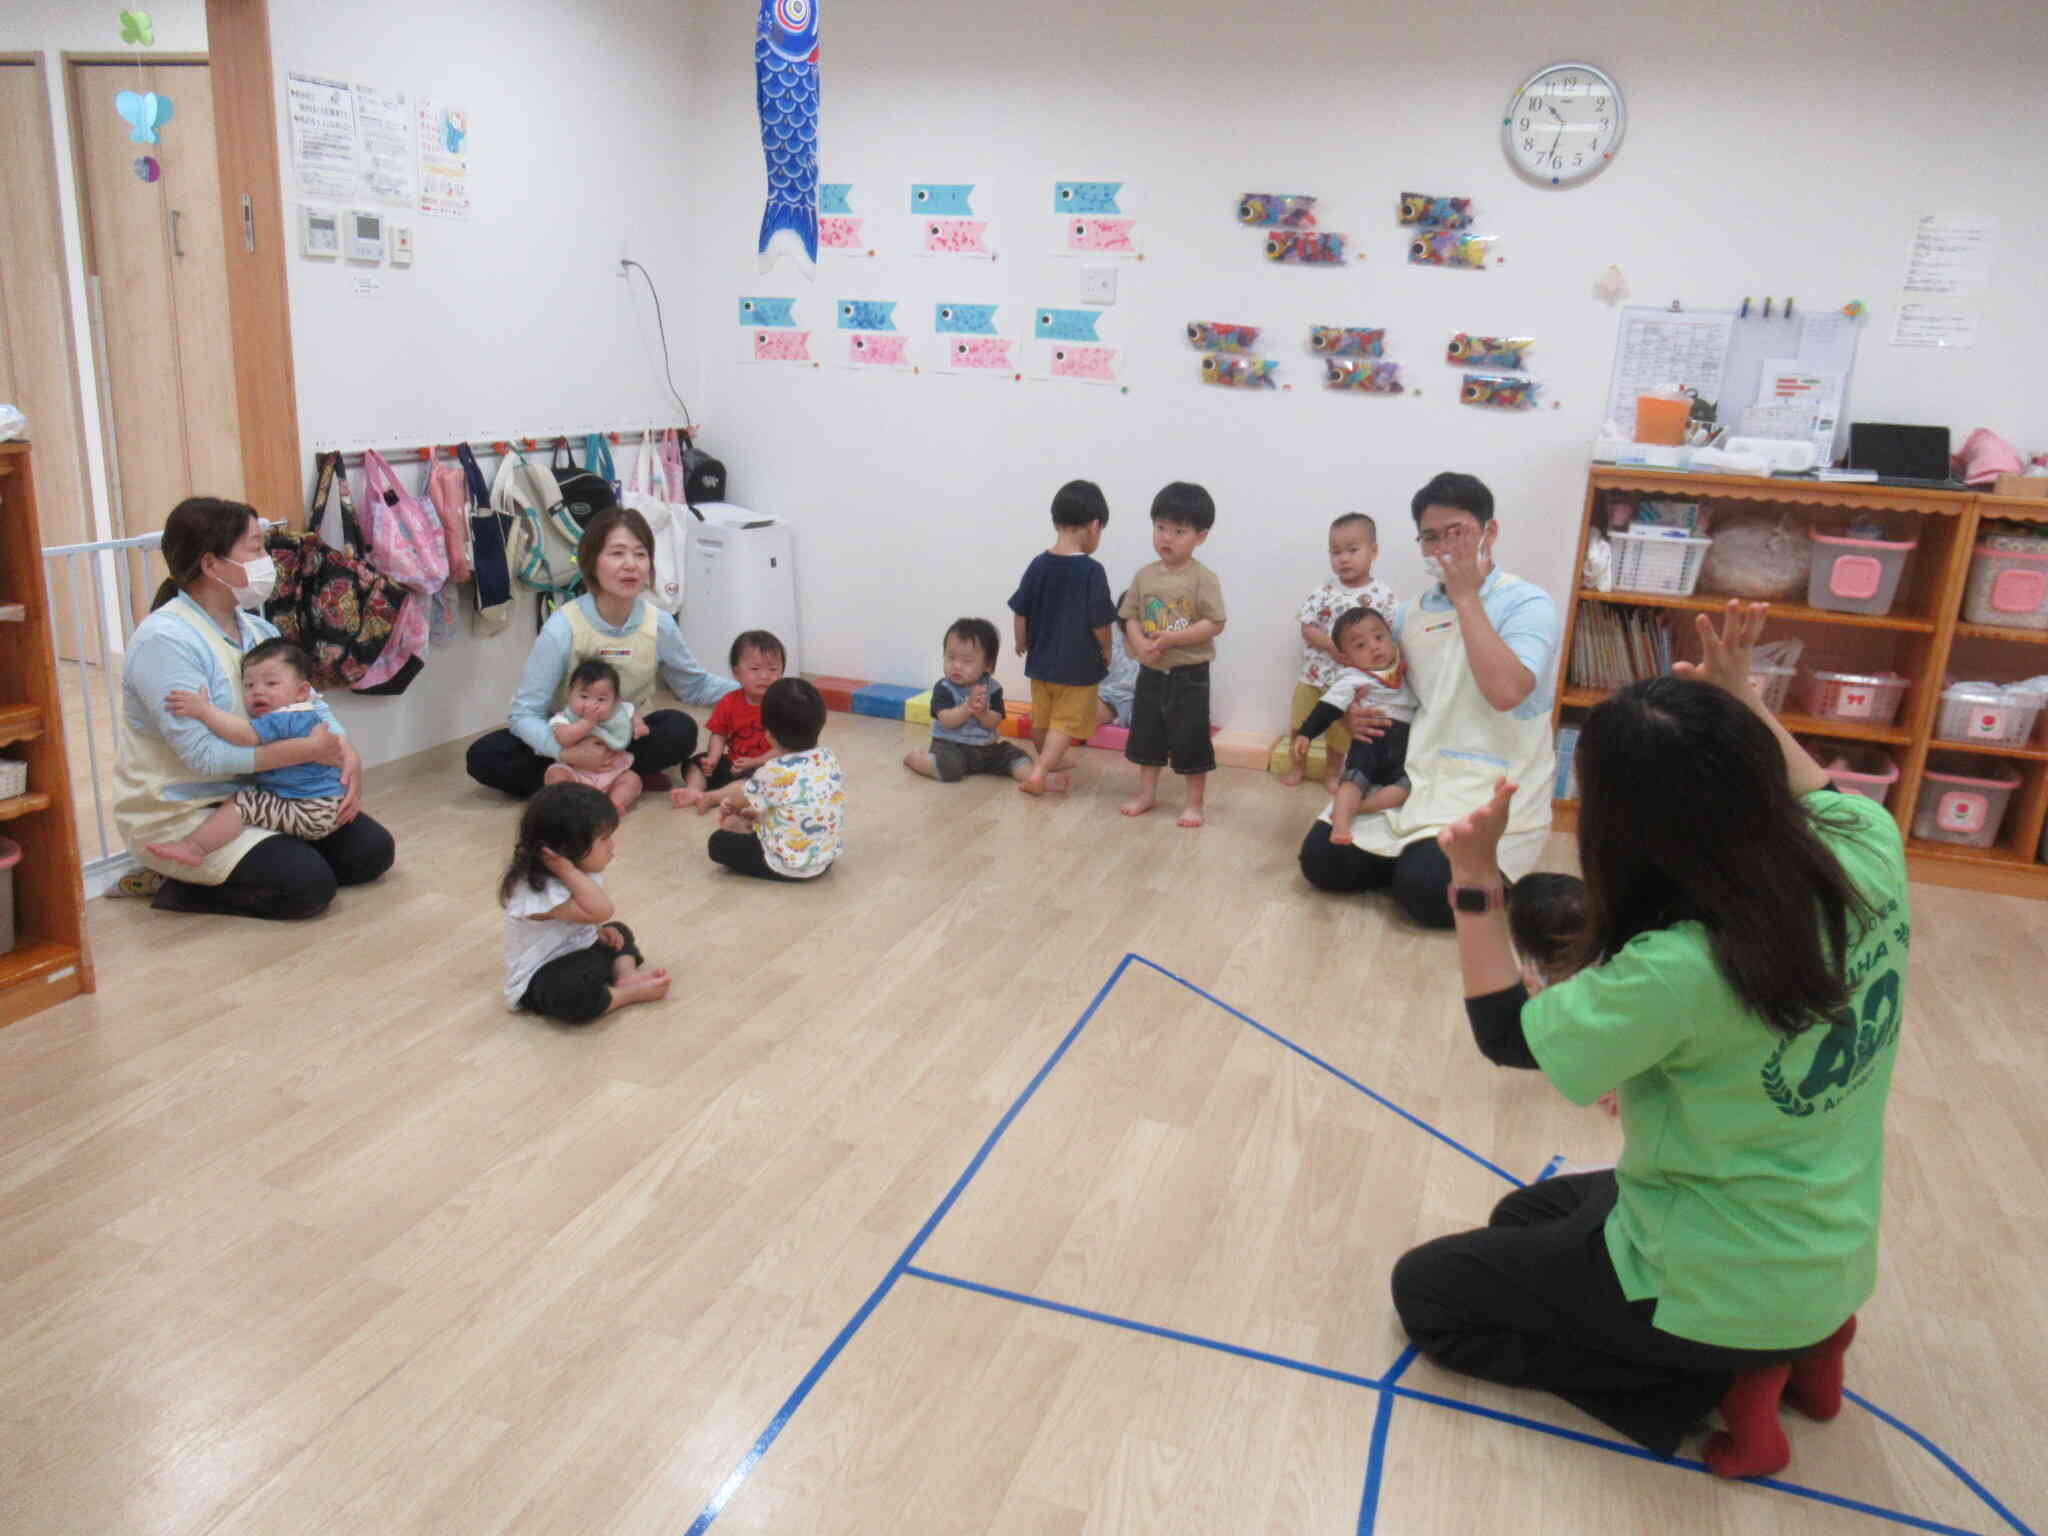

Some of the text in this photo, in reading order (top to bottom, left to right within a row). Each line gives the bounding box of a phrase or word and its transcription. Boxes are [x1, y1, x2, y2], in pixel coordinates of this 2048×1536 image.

[1528, 96, 1543, 112] 10
[1595, 96, 1606, 112] 2
[1519, 117, 1530, 132] 9
[1599, 117, 1609, 132] 3
[1522, 137, 1534, 152] 8
[1535, 151, 1546, 165] 7
[1551, 154, 1562, 169] 6
[1572, 152, 1583, 167] 5
